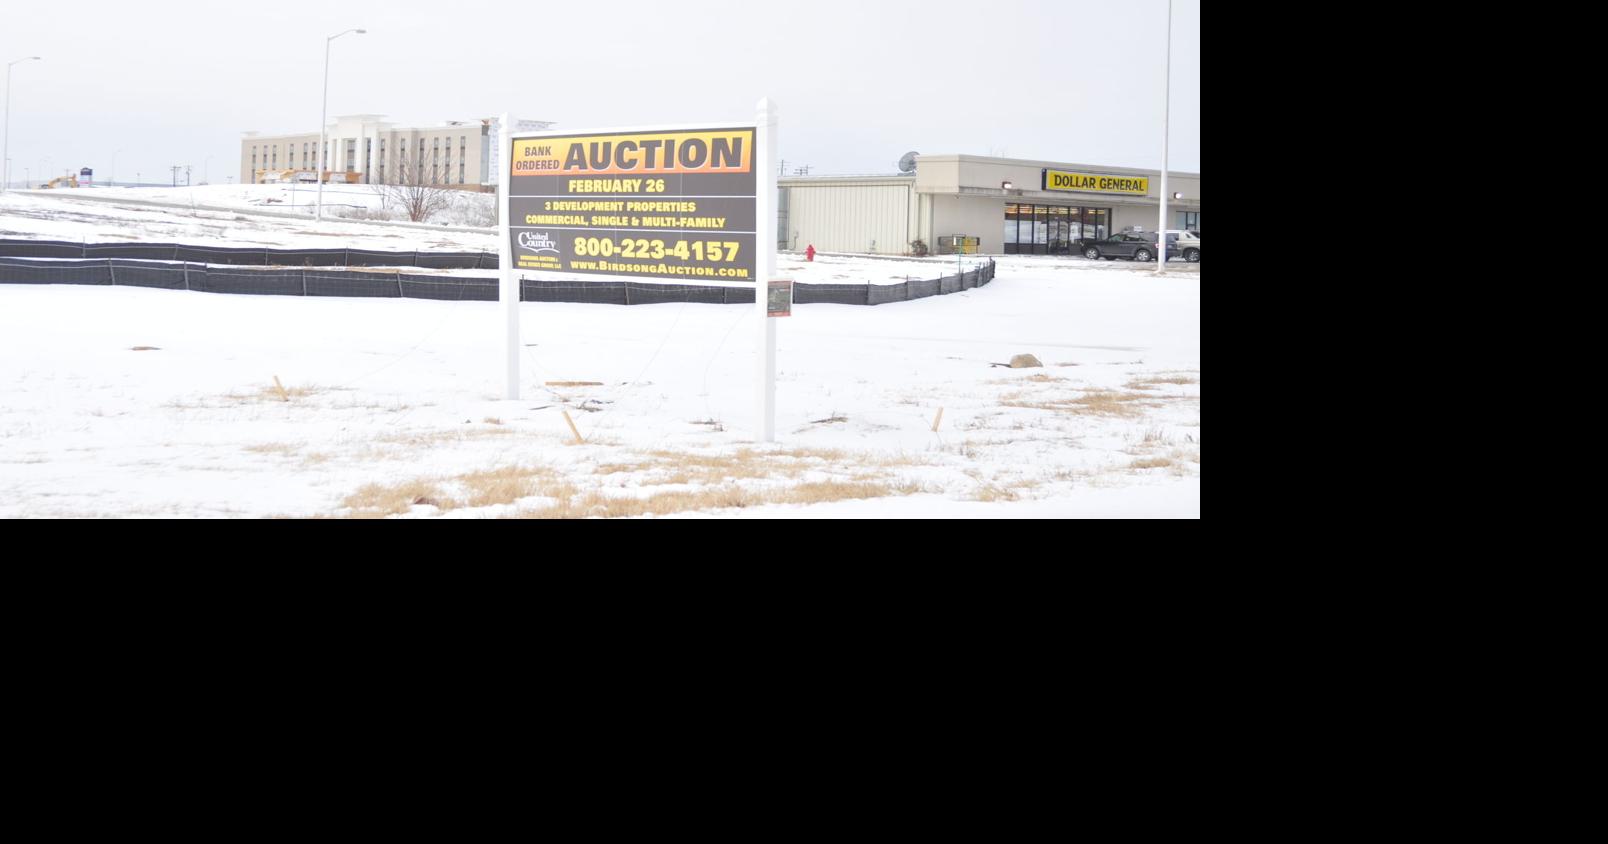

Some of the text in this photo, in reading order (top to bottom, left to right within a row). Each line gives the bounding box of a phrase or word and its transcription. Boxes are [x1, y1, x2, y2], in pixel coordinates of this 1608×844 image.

[524, 146, 552, 157] BANK
[563, 137, 743, 170] AUCTION
[516, 159, 560, 170] ORDERED
[568, 179, 665, 193] FEBRUARY 26
[1054, 174, 1144, 191] DOLLAR GENERAL
[544, 201, 697, 212] 3 DEVELOPMENT PROPERTIES
[525, 214, 726, 228] COMMERCIAL, SINGLE & MULTI-FAMILY
[518, 231, 556, 249] Country
[526, 231, 549, 241] United
[574, 237, 740, 262] 800-223-4157
